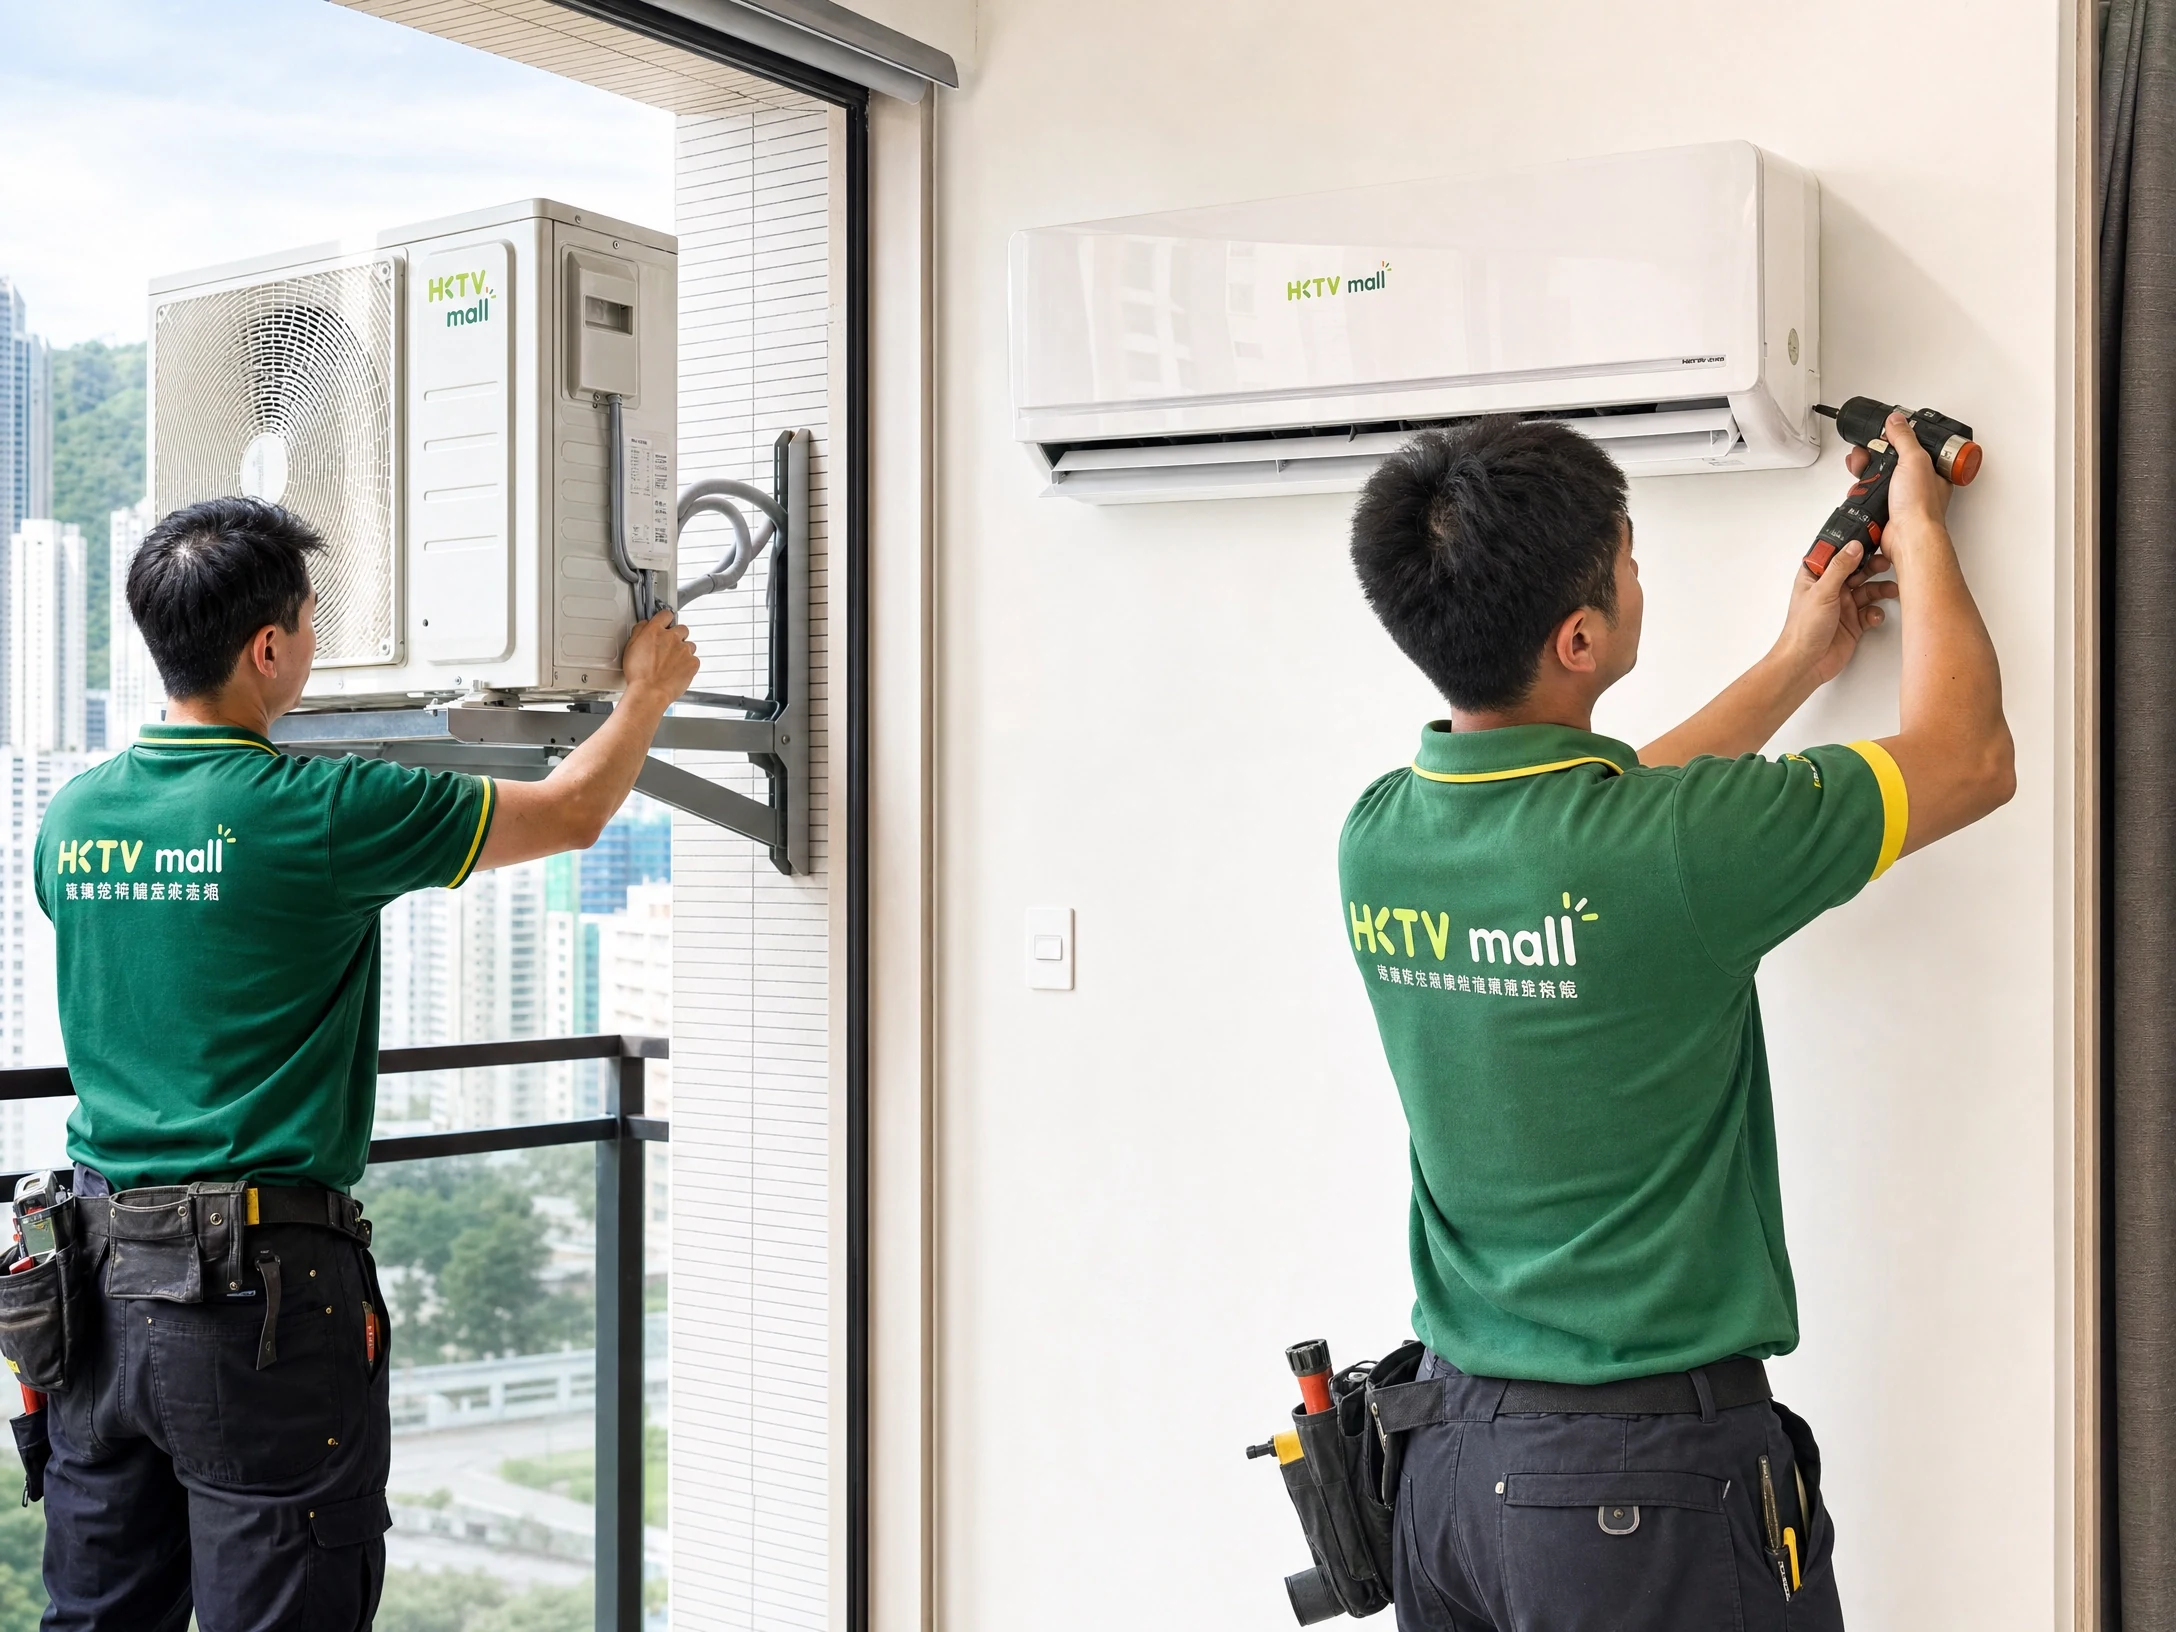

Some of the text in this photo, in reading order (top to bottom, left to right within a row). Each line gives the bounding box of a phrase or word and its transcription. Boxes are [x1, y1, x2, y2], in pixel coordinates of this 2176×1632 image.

[428, 270, 487, 303] HKTV
[1287, 270, 1386, 301] HKTV mall
[446, 298, 489, 328] mall
[57, 838, 223, 875] HKTV mall
[1349, 901, 1577, 967] HKTV mall
